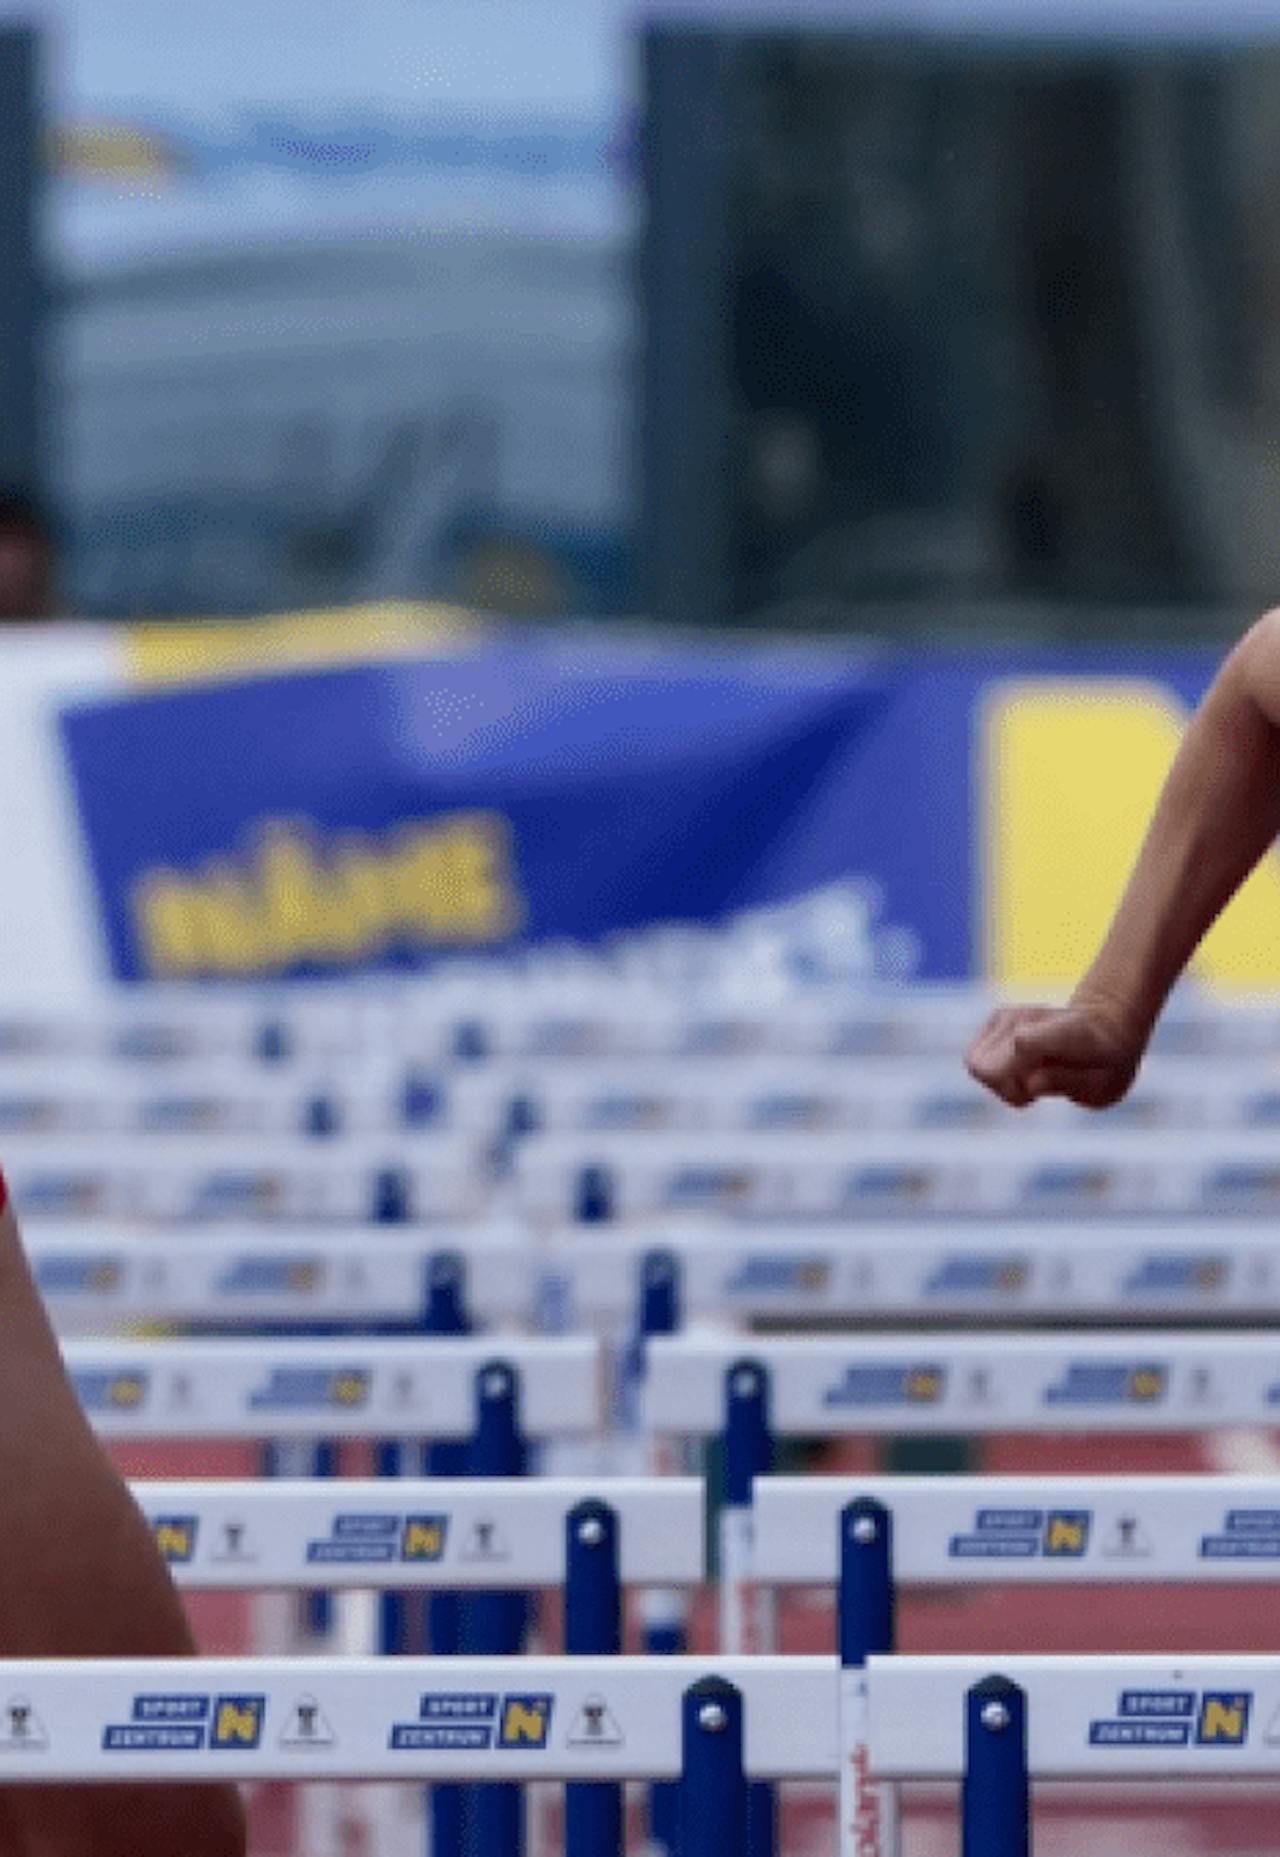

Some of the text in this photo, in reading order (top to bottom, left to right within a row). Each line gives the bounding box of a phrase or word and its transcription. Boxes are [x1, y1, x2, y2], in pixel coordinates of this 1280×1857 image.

[214, 1704, 255, 1743] N
[501, 1702, 542, 1741] N
[1200, 1699, 1241, 1738] N
